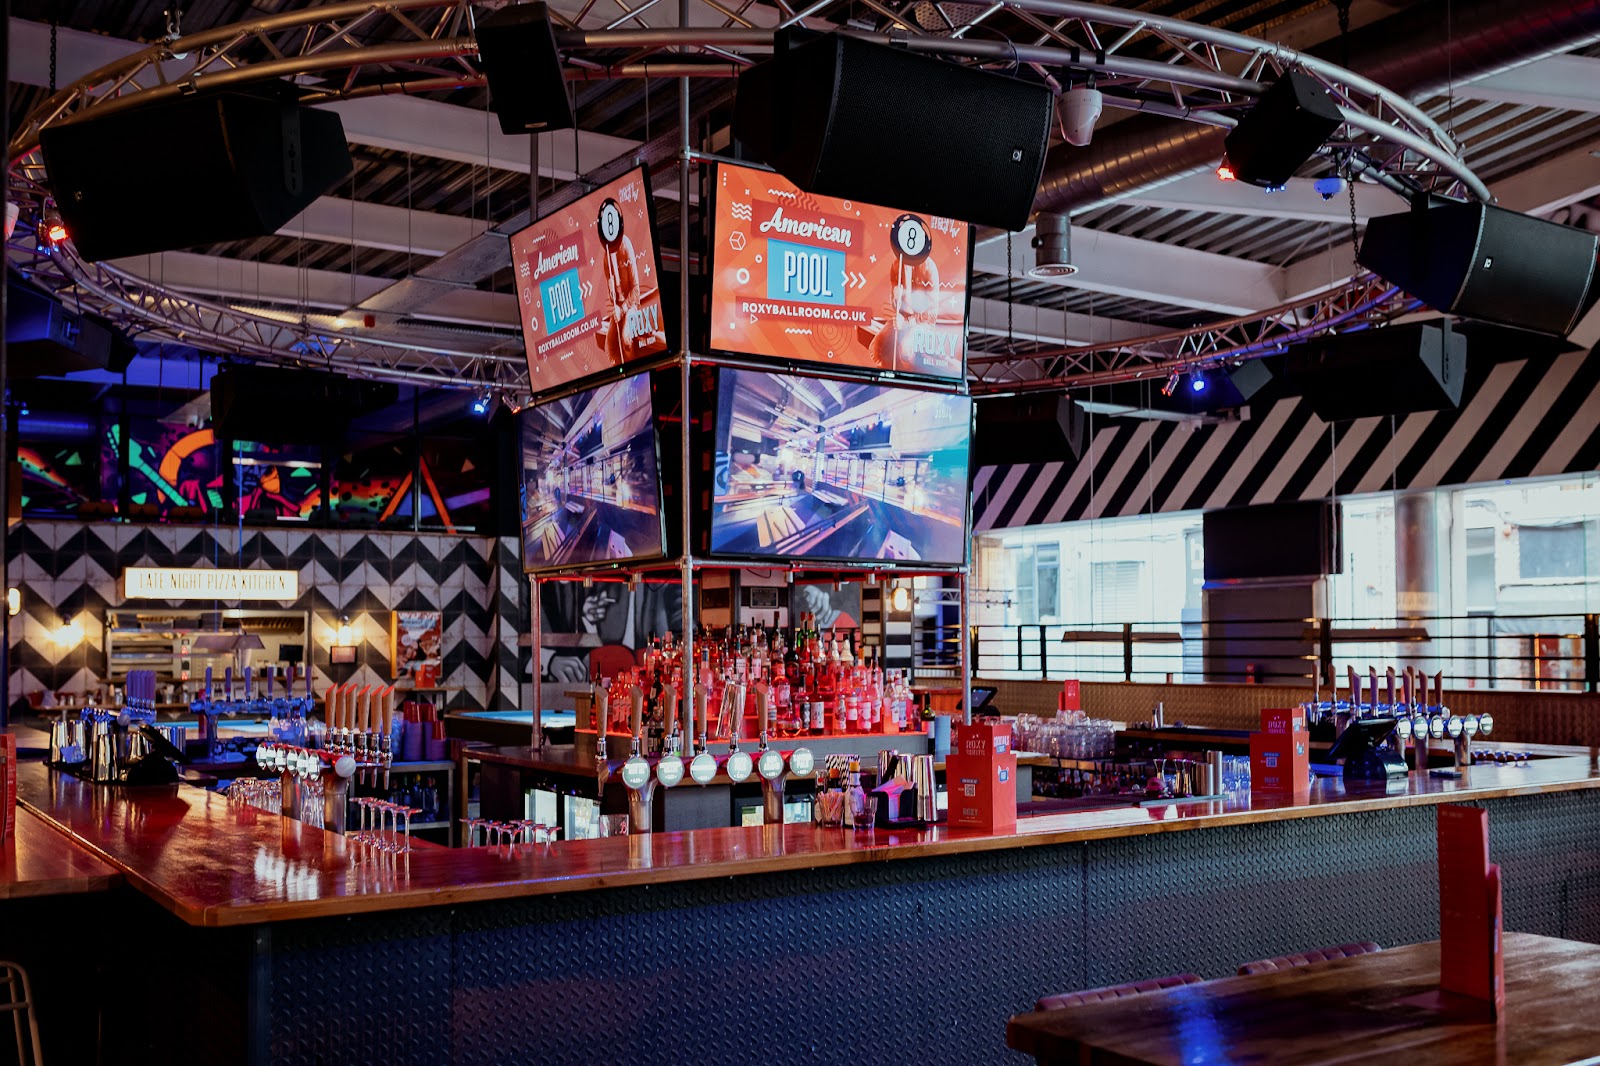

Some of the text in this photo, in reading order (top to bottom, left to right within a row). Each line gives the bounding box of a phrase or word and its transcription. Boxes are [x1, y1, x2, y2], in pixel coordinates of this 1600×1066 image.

[607, 211, 614, 236] 8
[759, 206, 852, 247] American
[907, 227, 917, 250] 8
[533, 243, 579, 280] American
[783, 250, 833, 297] POOL
[548, 277, 578, 325] POOL
[742, 301, 867, 322] ROXYBALLROOM.CO.UK
[628, 303, 659, 339] ROXY
[538, 316, 600, 355] ROXYBALLROOM.CO.UK
[913, 328, 959, 359] ROXY
[139, 572, 286, 590] LATE NIGHT PIZZA KITCHEN
[1267, 720, 1287, 730] ROXY
[965, 739, 986, 749] ROXY
[962, 807, 979, 817] ROXY
